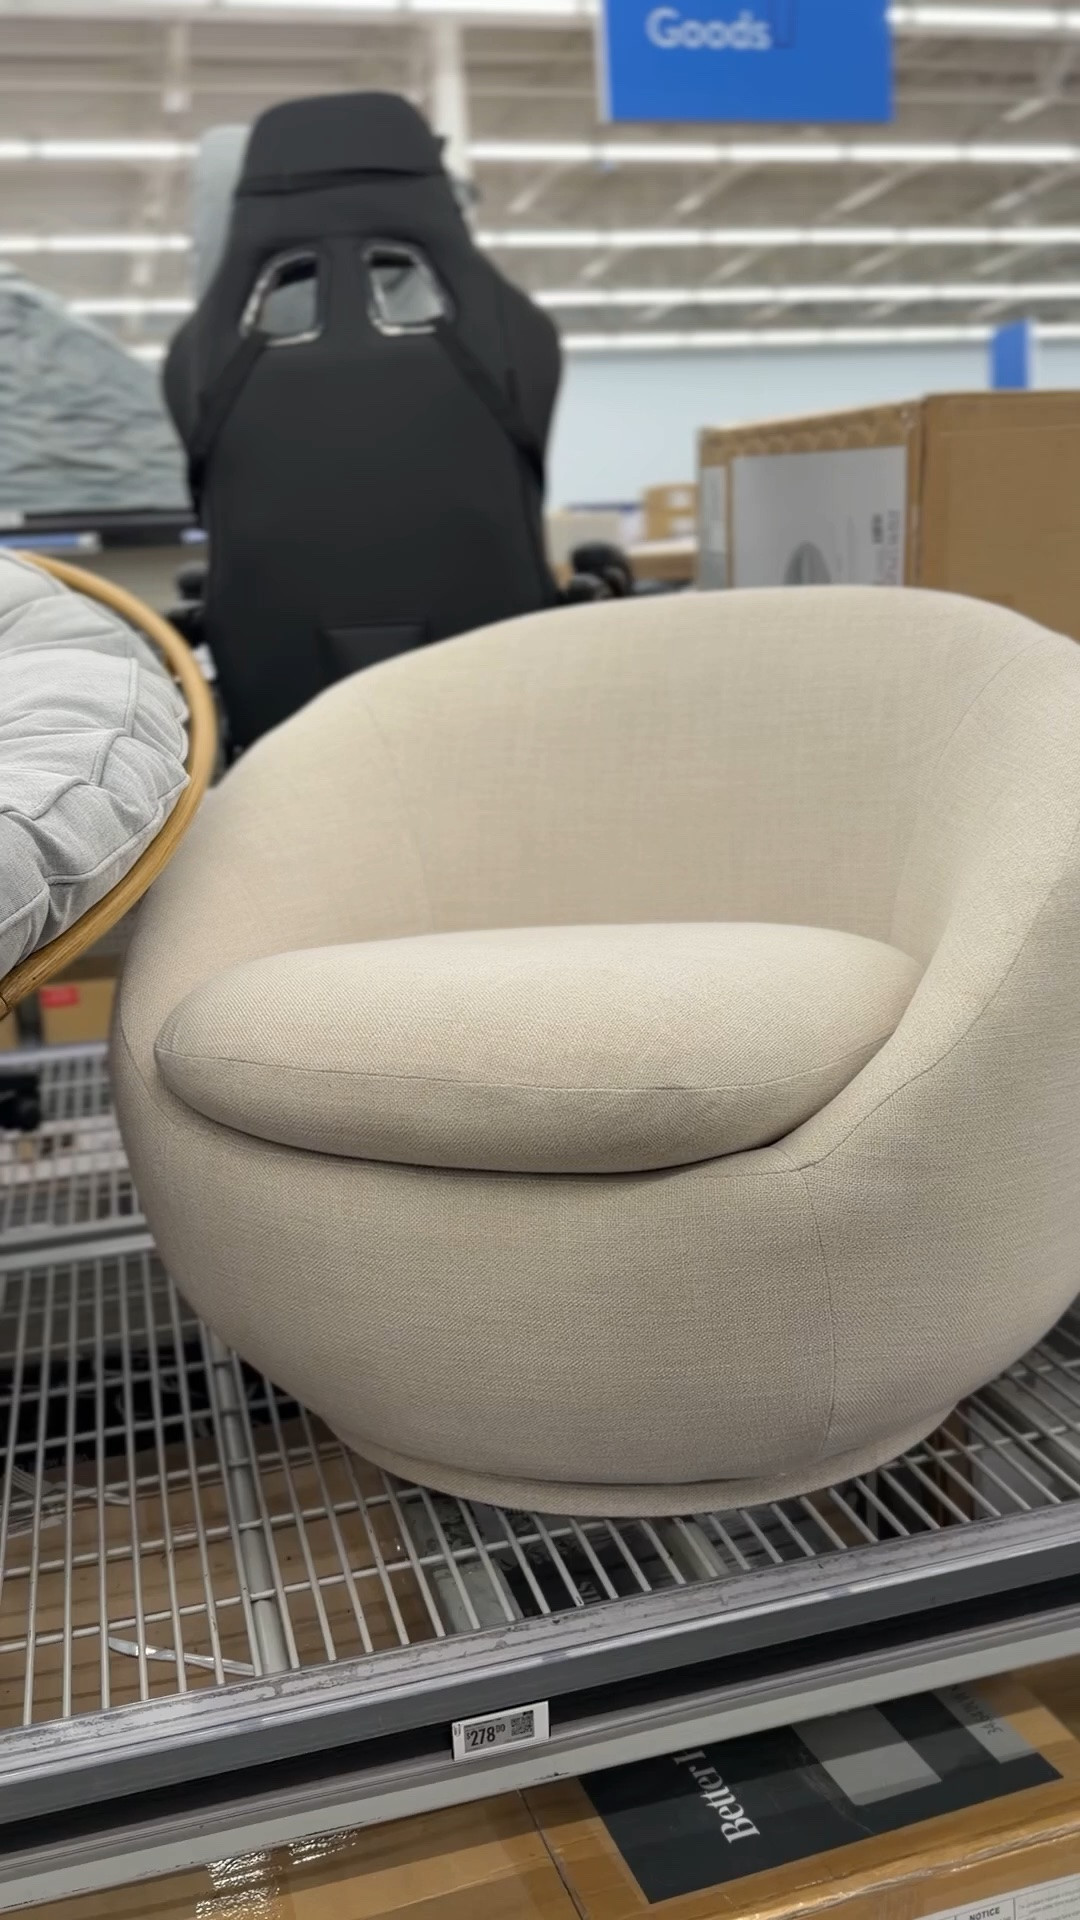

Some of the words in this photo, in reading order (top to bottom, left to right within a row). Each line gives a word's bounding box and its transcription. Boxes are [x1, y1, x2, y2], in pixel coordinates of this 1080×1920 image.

[646, 6, 772, 50] Goods
[688, 1766, 760, 1844] Better
[969, 1906, 1001, 1920] NOTICE
